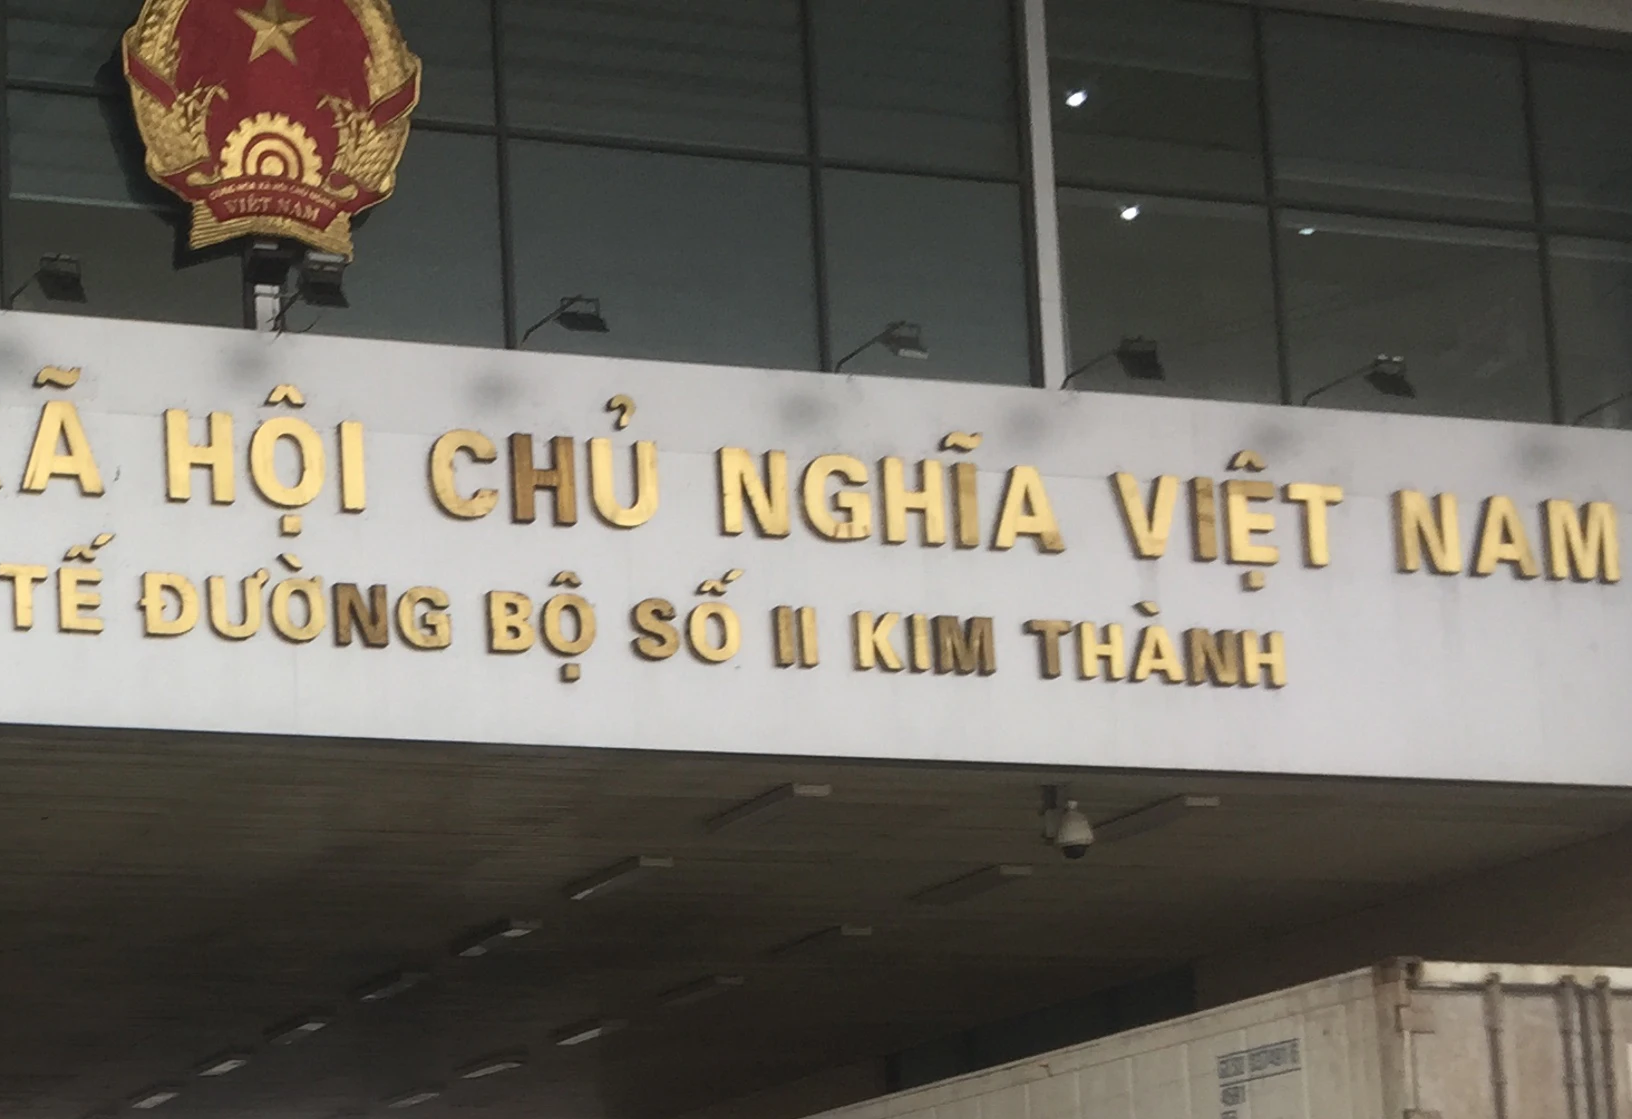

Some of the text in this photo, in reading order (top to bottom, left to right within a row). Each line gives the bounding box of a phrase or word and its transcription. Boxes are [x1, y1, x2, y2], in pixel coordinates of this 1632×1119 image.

[275, 197, 321, 222] NAM
[163, 383, 367, 535] HỘI
[426, 394, 659, 529] CHỦ
[717, 431, 1066, 555] NGHĨA
[1110, 450, 1344, 592] VIỆT
[1392, 488, 1623, 585] NAM
[138, 553, 452, 652] ĐƯỜNG
[485, 569, 598, 683] BỘ
[629, 567, 744, 666] SỐ
[771, 604, 820, 669] II
[850, 609, 998, 676] KIM
[1023, 602, 1290, 690] THÀNH
